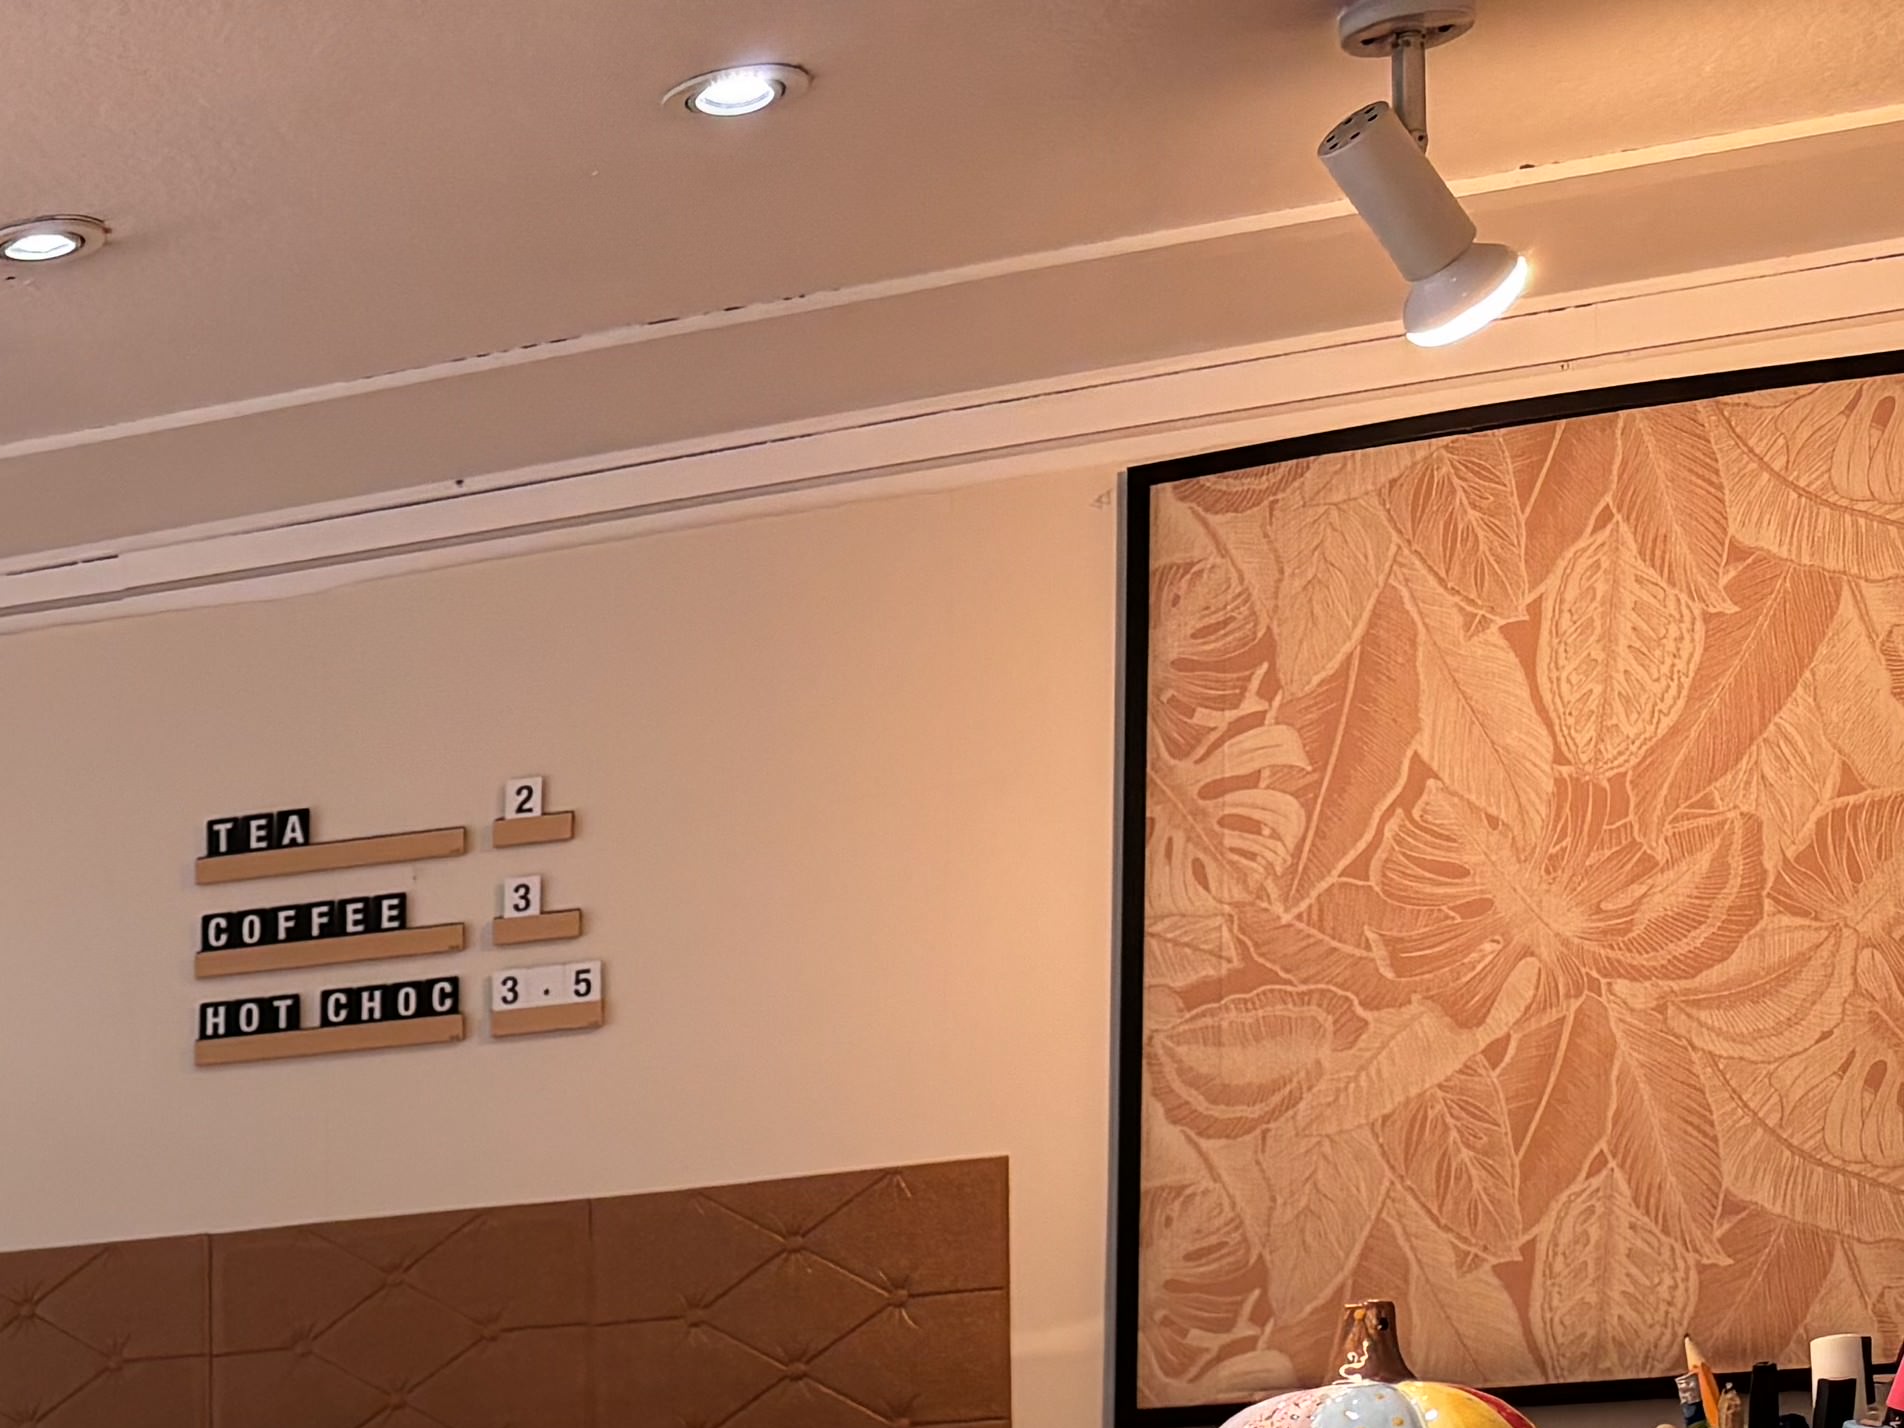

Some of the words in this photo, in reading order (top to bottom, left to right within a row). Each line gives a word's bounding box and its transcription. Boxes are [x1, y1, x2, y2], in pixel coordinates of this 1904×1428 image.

[212, 814, 305, 853] TEA
[514, 785, 535, 814] 2
[207, 898, 401, 948] COFFEE
[512, 883, 532, 912] 3
[205, 998, 293, 1036] HOT
[326, 980, 454, 1023] CHOC
[500, 968, 592, 1005] 3.5
